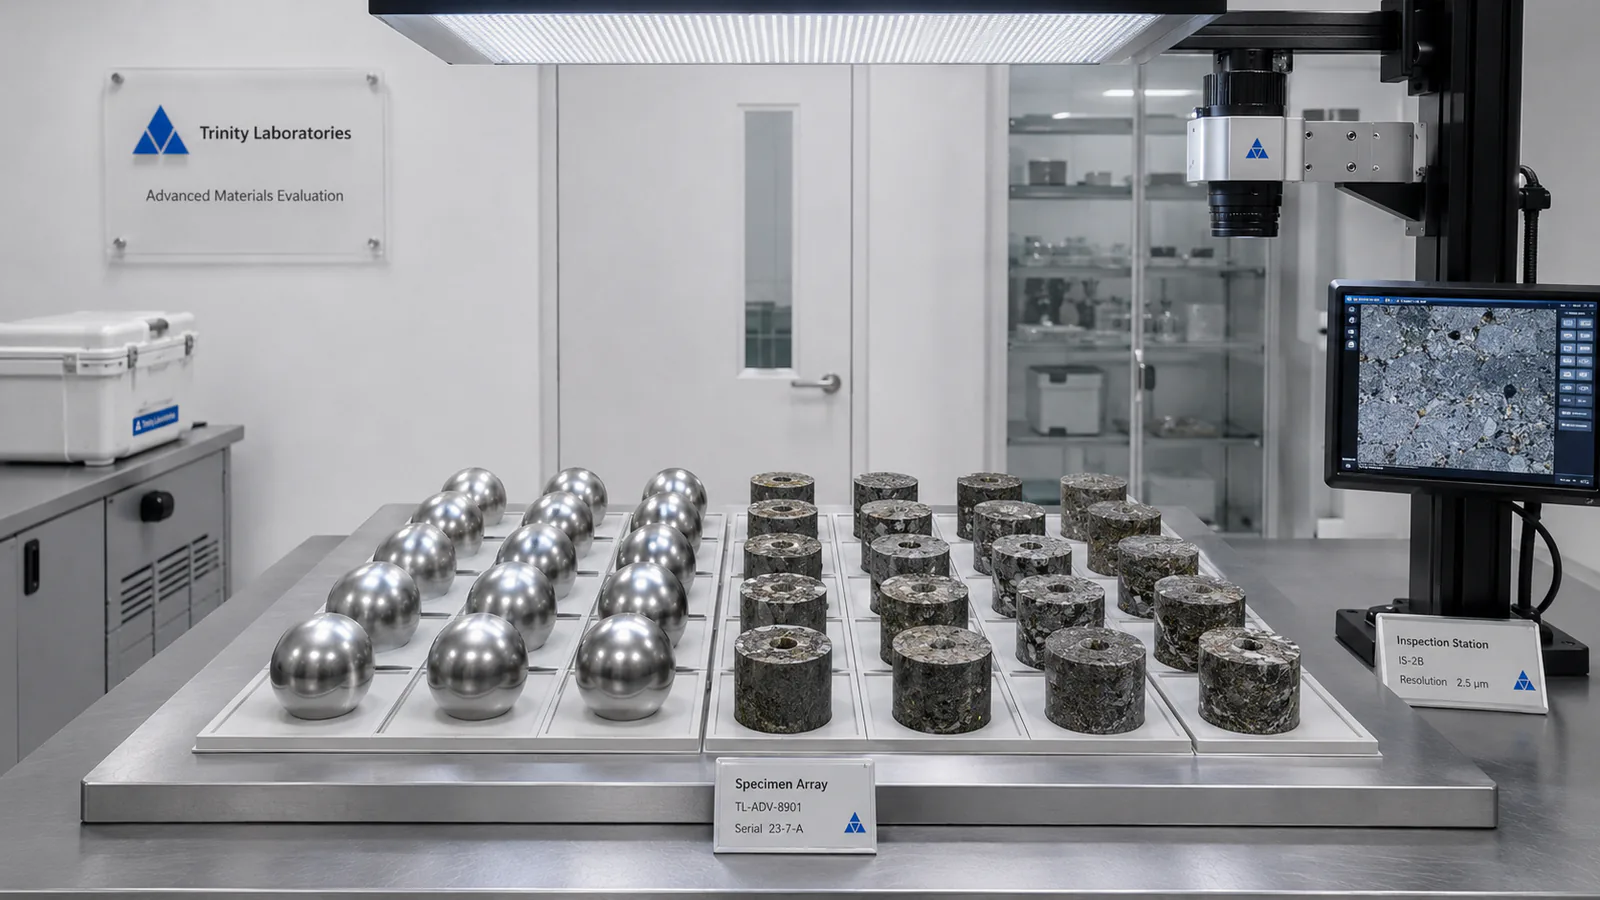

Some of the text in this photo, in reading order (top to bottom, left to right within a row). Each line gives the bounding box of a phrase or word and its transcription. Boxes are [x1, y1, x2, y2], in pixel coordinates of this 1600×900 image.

[199, 125, 352, 143] Trinity Laboratories
[145, 188, 345, 202] Advanced Materials Evaluation
[1396, 635, 1489, 650] Inspection Station
[1398, 655, 1425, 667] IS-2B
[1399, 674, 1489, 690] Resolution 2.5 µm
[735, 778, 829, 793] Specimen Array
[735, 801, 802, 813] TL-ADV-8901
[734, 823, 804, 834] Serial 23-7-A
